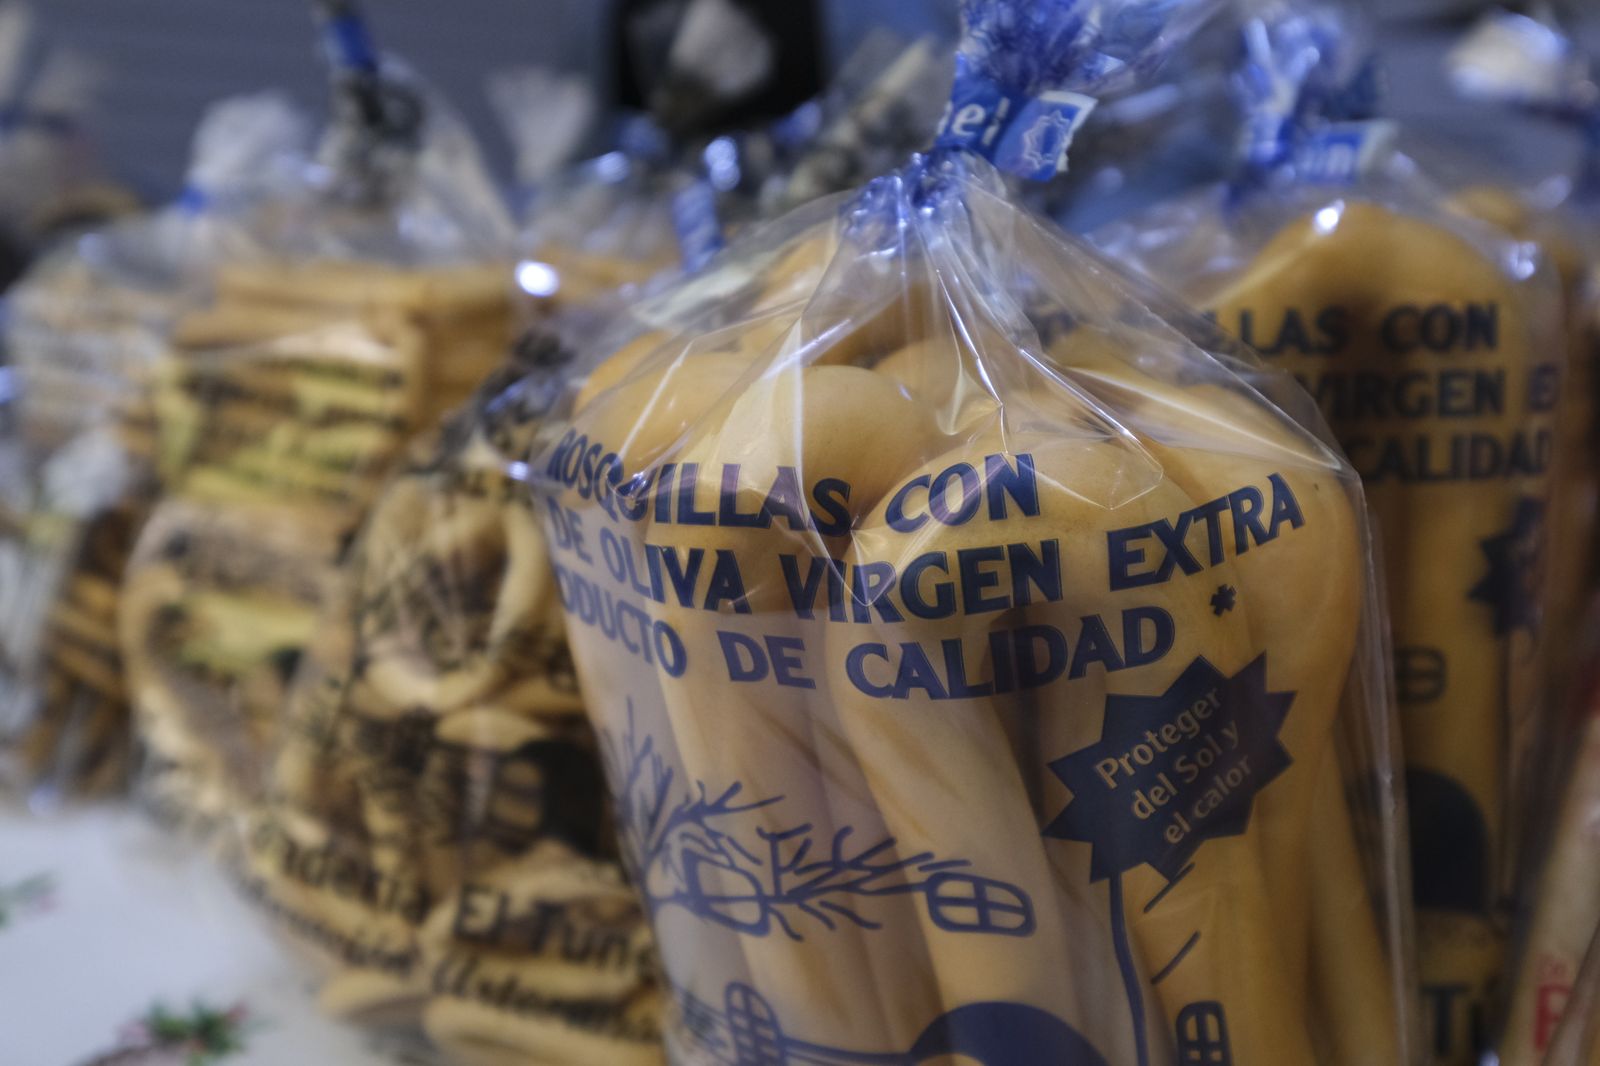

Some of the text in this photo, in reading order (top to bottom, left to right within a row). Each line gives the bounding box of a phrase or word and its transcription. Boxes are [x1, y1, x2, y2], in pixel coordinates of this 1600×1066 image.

[1380, 303, 1499, 353] CON
[546, 428, 1041, 538] ROSQUILLAS CON
[546, 472, 1306, 624] DE OLIVA VIRGEN EXTRA
[556, 564, 1176, 701] ODUCTO DE CALIDAD
[1094, 687, 1223, 789] Proteger
[1132, 719, 1240, 820] del Sol y
[1163, 754, 1253, 844] el calor
